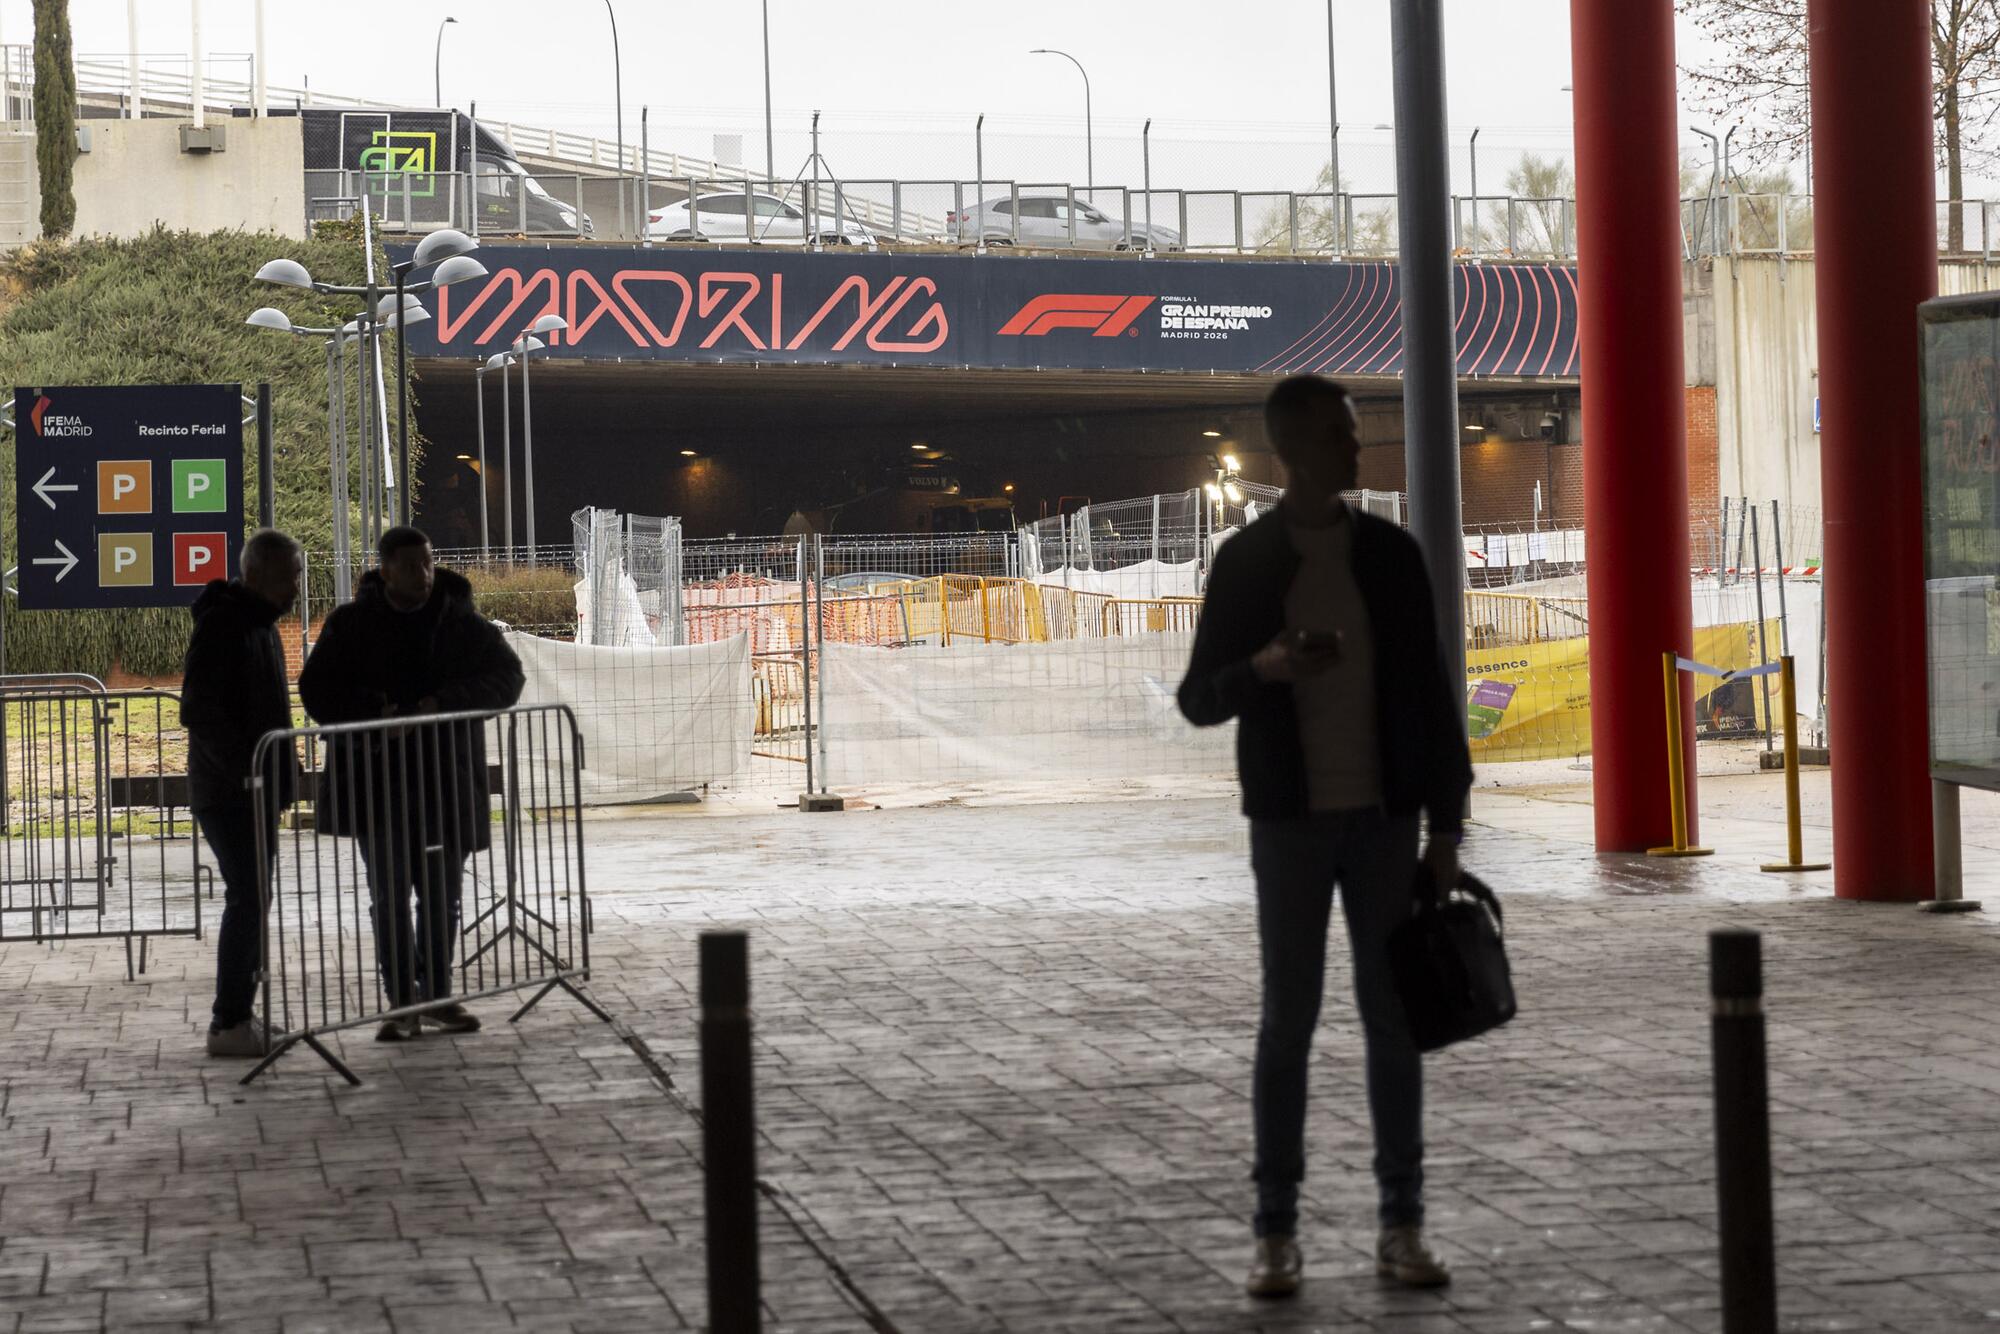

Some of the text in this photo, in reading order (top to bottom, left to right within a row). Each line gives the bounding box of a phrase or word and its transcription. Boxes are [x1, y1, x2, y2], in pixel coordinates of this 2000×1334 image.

[360, 147, 425, 180] GTA
[438, 267, 949, 353] MADRING
[1161, 304, 1273, 318] GRAN PREMIO
[1161, 316, 1249, 330] DE ESPAÑA
[1160, 331, 1200, 339] MADRID
[44, 416, 82, 426] IFEMA
[44, 426, 93, 437] MADRID
[139, 424, 226, 436] Recinto Ferial
[113, 474, 136, 500] P
[187, 473, 210, 499] P
[909, 476, 938, 486] VOLVO
[114, 546, 137, 573] P
[188, 546, 212, 572] P
[1467, 659, 1528, 675] essence
